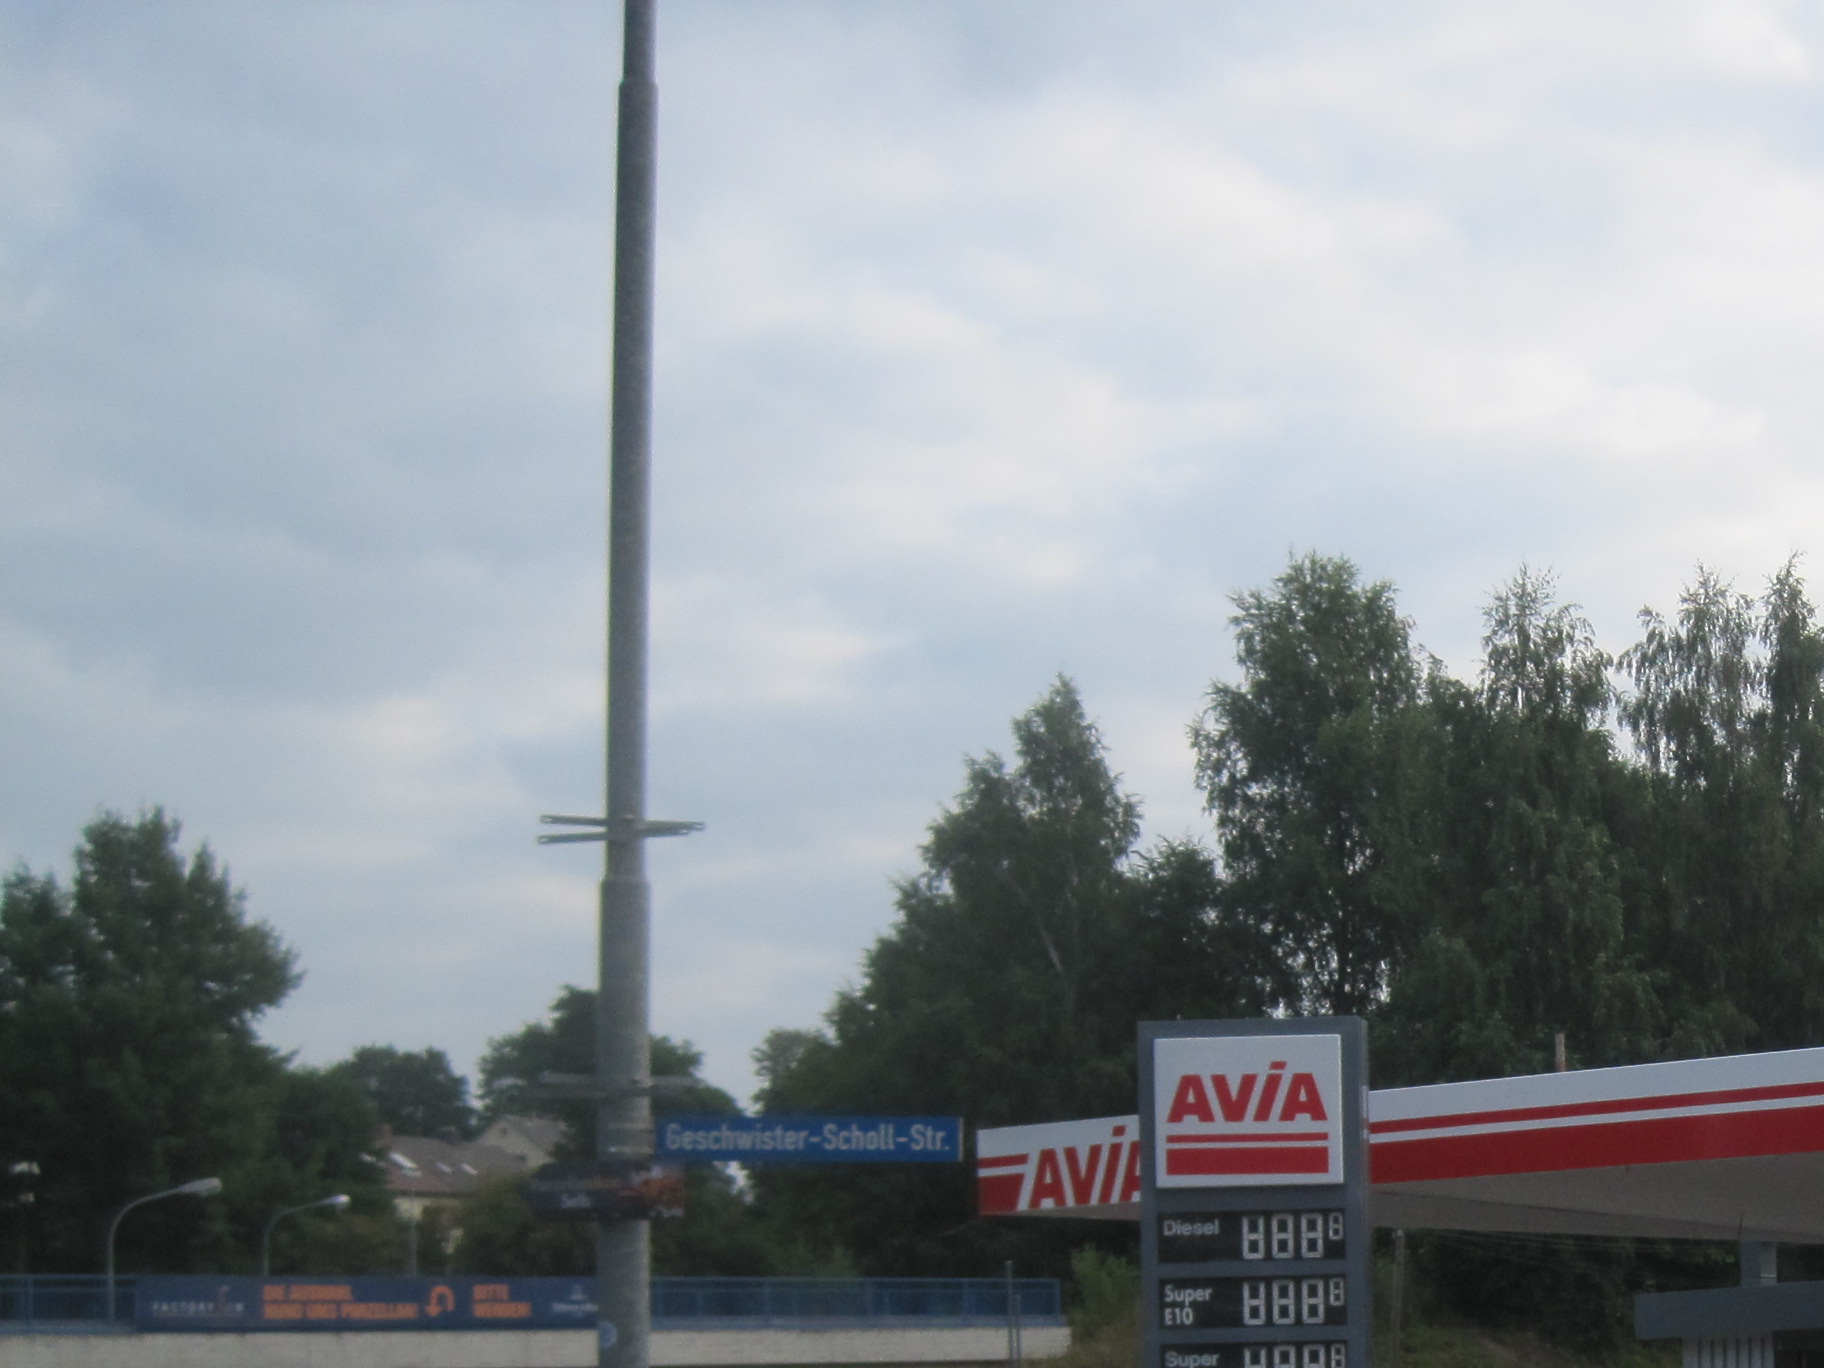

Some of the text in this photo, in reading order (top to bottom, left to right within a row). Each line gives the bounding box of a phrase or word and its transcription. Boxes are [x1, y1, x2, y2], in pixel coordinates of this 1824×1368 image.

[1166, 1061, 1328, 1123] AVIA
[667, 1122, 950, 1150] Geschwister-Scholl-Str.
[1163, 1219, 1221, 1236] Diesel
[1164, 1284, 1212, 1304] Super
[1164, 1307, 1194, 1326] E10
[1165, 1351, 1220, 1368] Super
